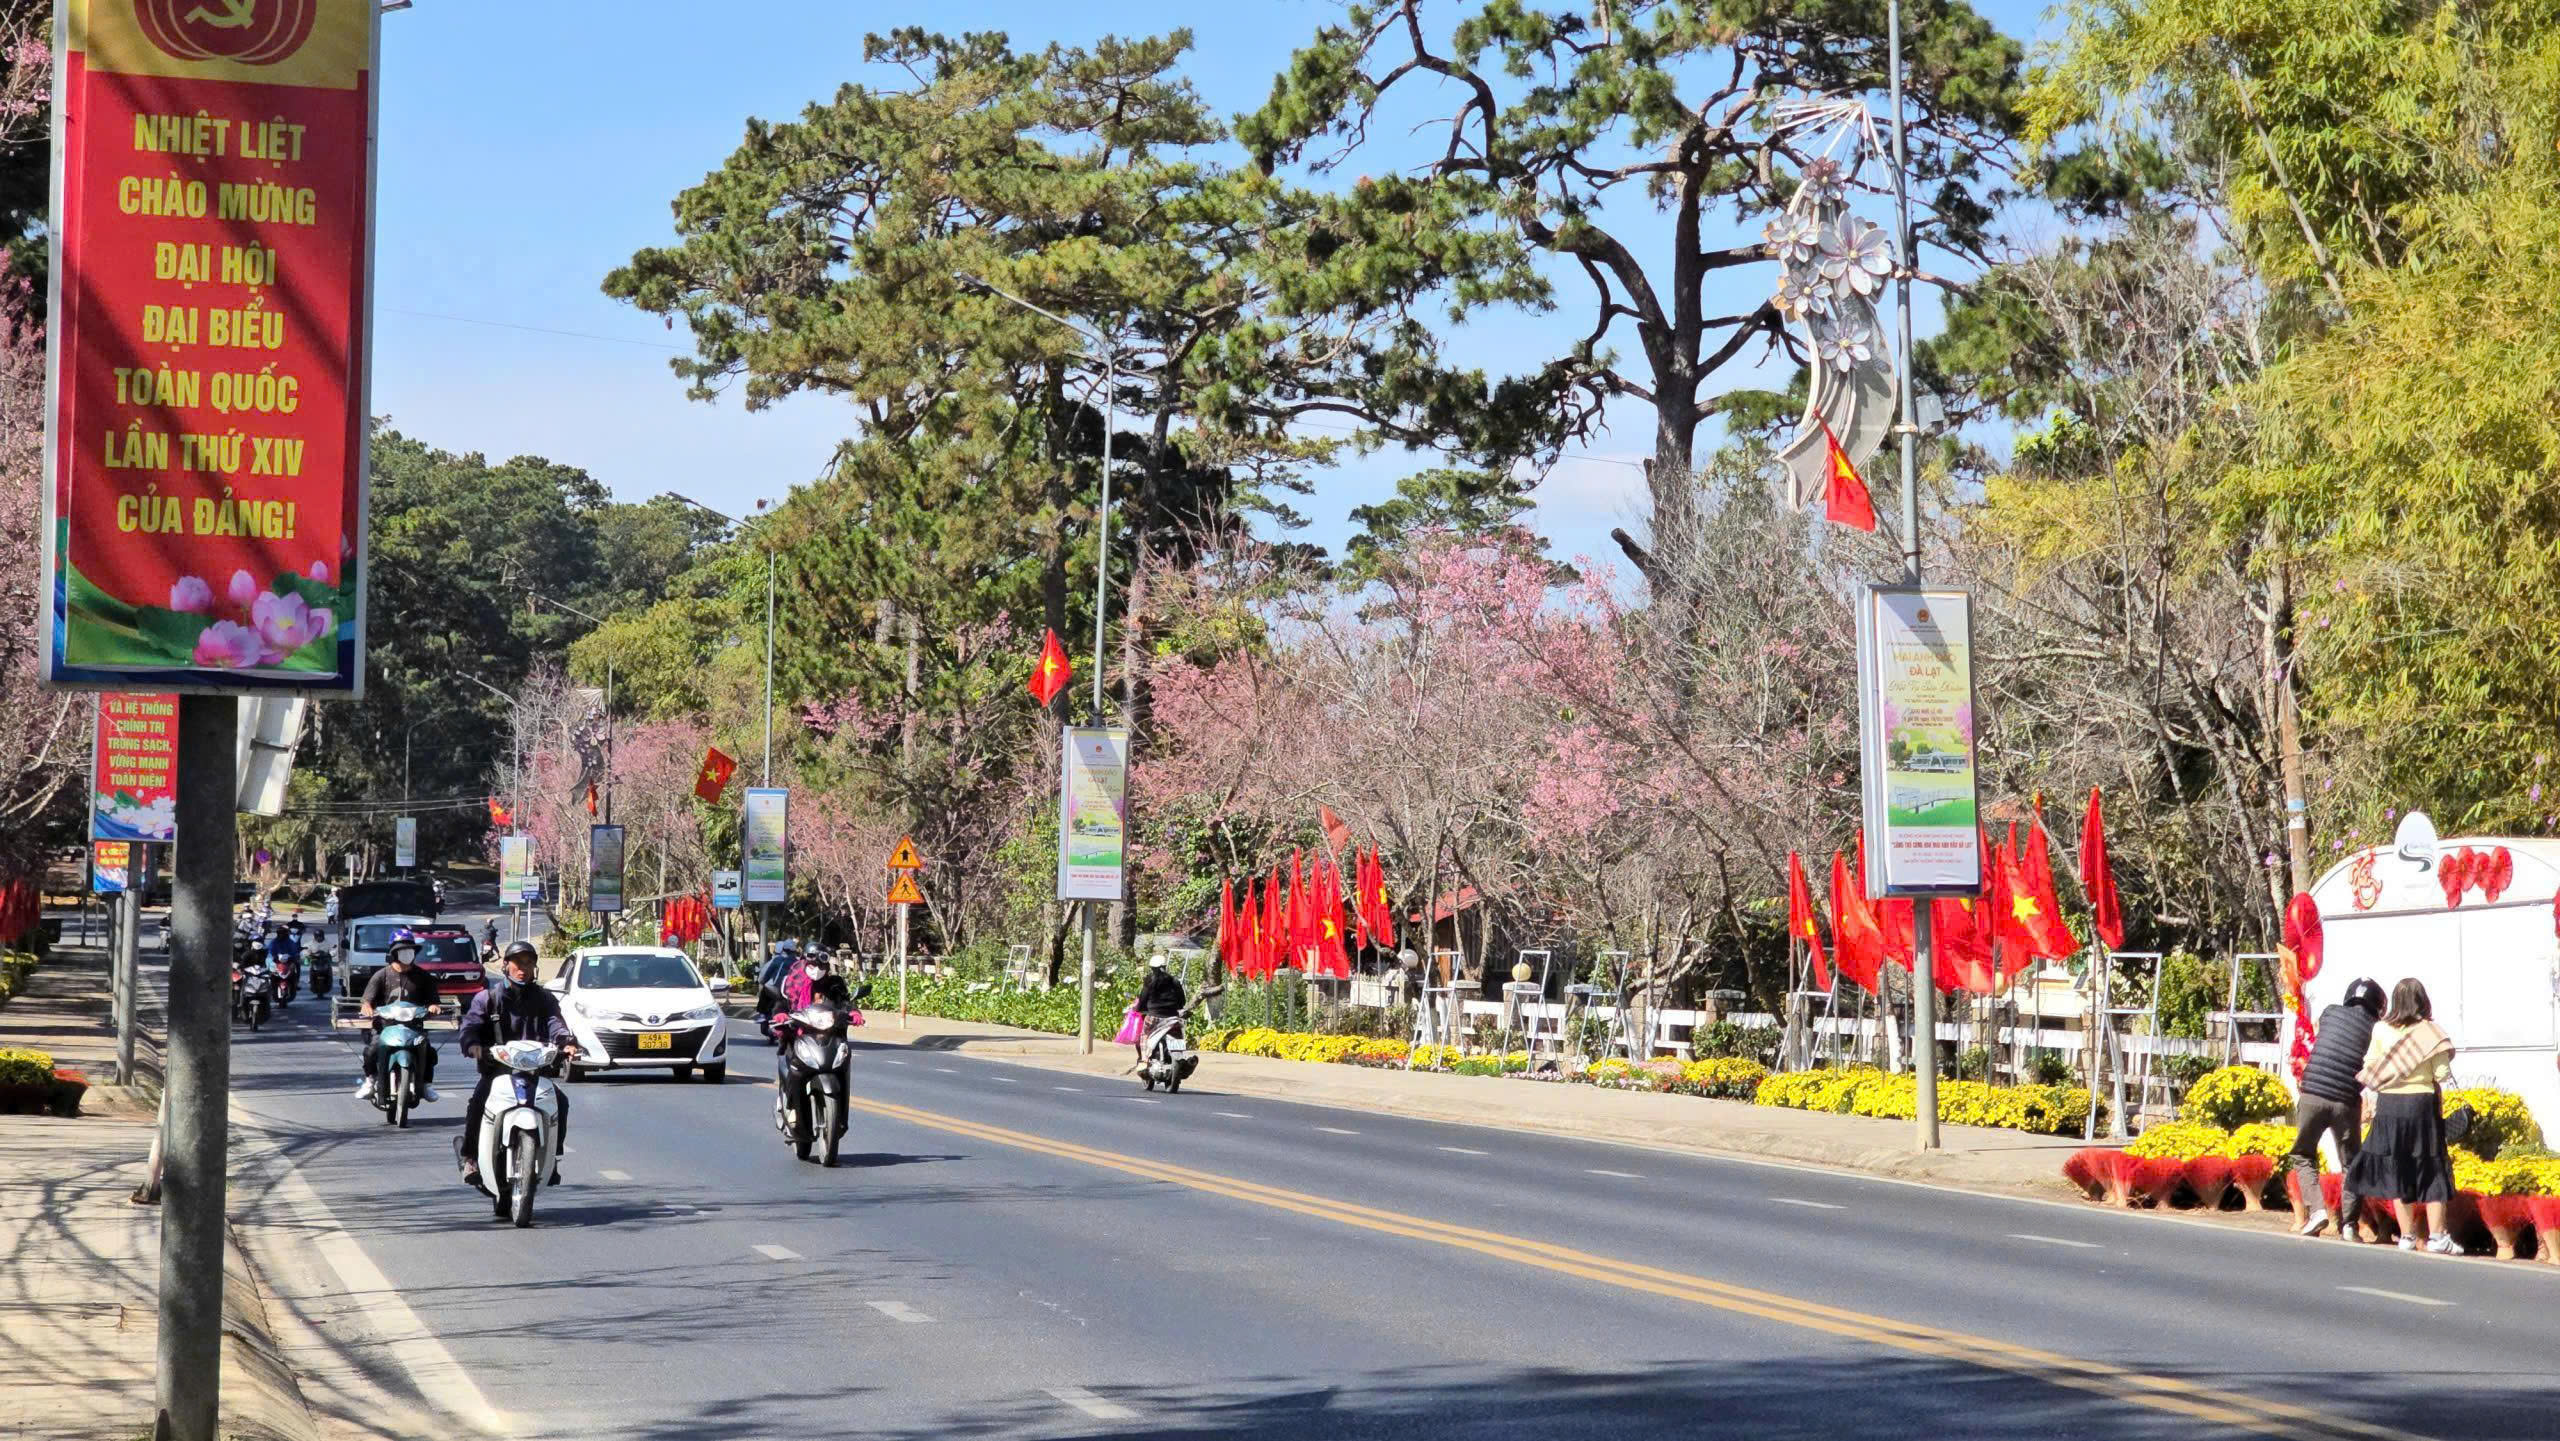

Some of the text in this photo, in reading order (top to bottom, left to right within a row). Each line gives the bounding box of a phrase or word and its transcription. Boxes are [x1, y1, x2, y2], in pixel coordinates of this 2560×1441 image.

[134, 109, 306, 169] NHIỆT LIỆT
[118, 171, 316, 226] CHÀO MỪNG
[155, 240, 276, 294] ĐẠI HỘI
[142, 296, 284, 352] ĐẠI BIỂU
[114, 360, 299, 414] TOÀN QUỐC
[105, 417, 304, 478] LẦN THỨ XIV
[117, 483, 297, 540] CỦA ĐẢNG!
[109, 698, 174, 718] VÀ HỆ THỐNG
[108, 736, 140, 751] TRONG
